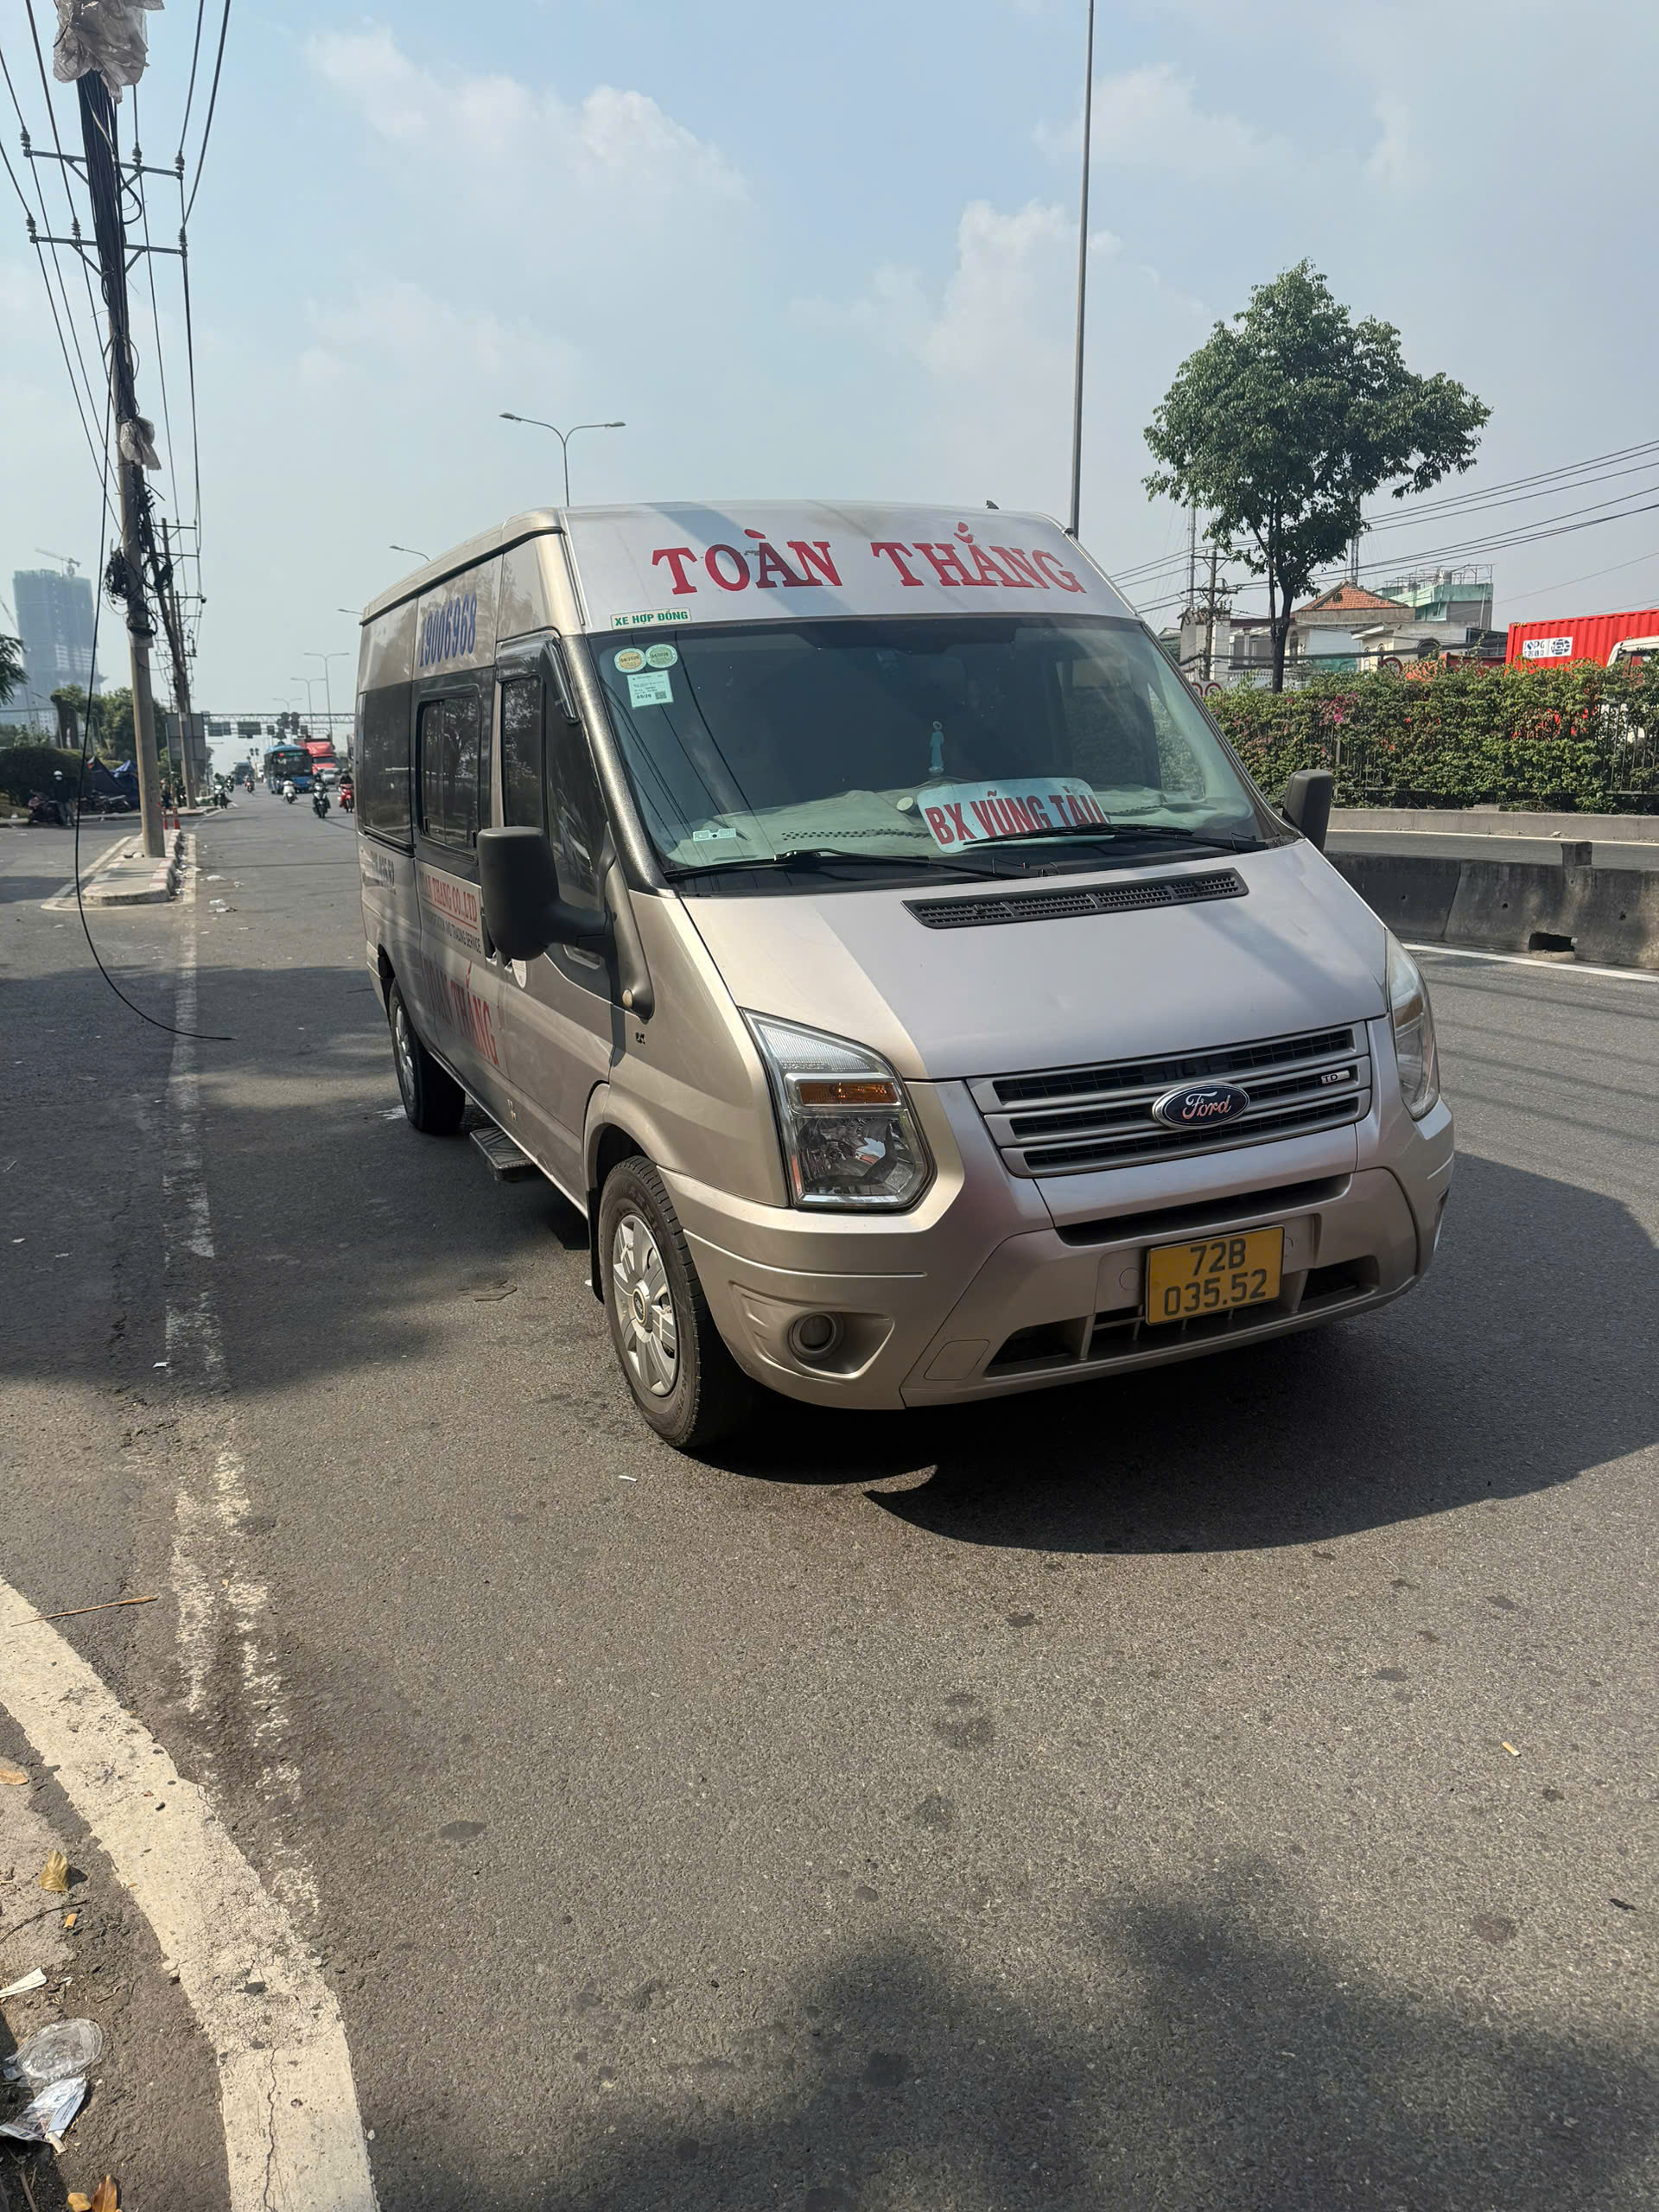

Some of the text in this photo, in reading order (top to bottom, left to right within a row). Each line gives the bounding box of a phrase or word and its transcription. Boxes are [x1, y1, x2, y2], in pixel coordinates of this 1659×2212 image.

[652, 522, 1087, 595] TOÀN THẮNG
[419, 594, 477, 668] 19006968
[614, 608, 689, 626] XE HỢP ĐỒNG
[925, 802, 976, 845] BX
[969, 790, 1052, 837] VŨNG
[1181, 1090, 1232, 1120] Ford
[1190, 1238, 1246, 1276] 72B
[1164, 1268, 1267, 1316] 035.52
